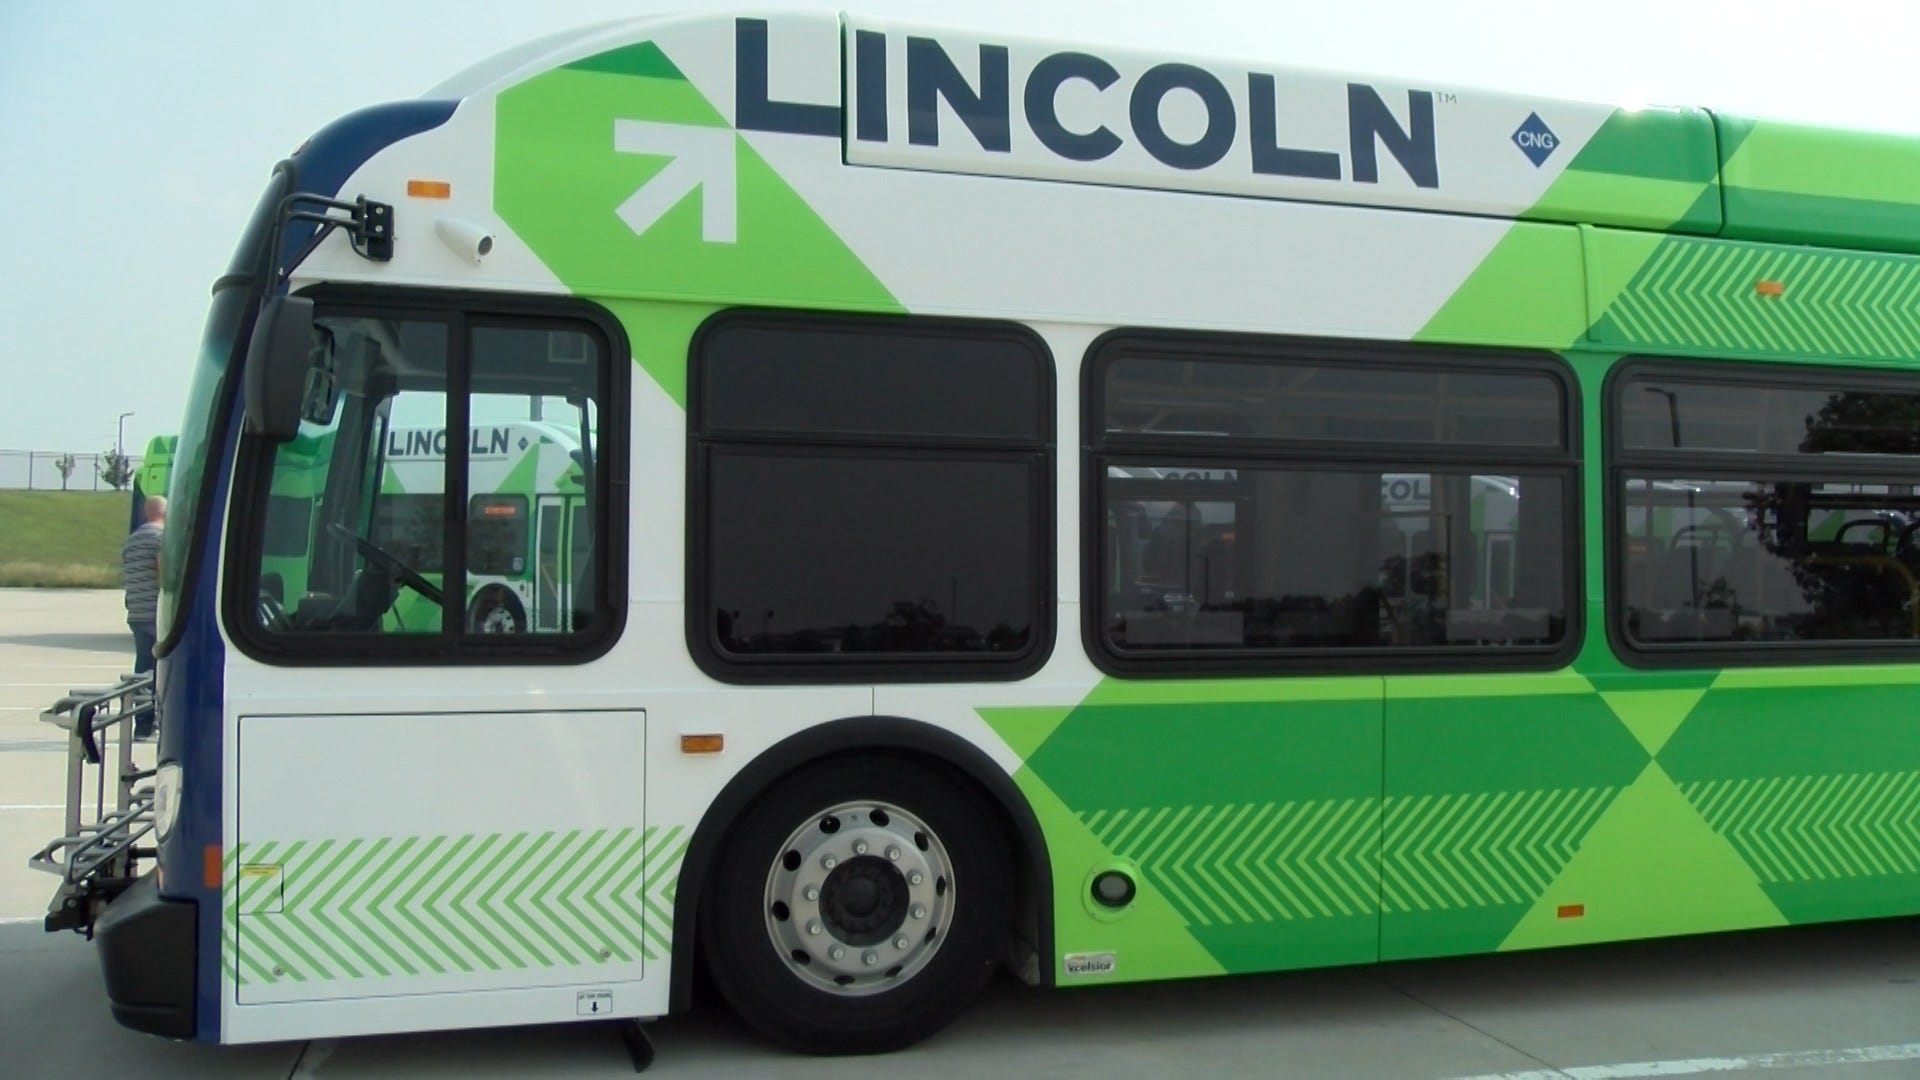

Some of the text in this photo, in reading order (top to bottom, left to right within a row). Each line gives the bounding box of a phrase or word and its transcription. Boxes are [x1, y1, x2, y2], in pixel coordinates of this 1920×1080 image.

[735, 17, 1439, 189] LINCOLN
[1517, 130, 1555, 149] CNG
[388, 427, 510, 456] LINCLN
